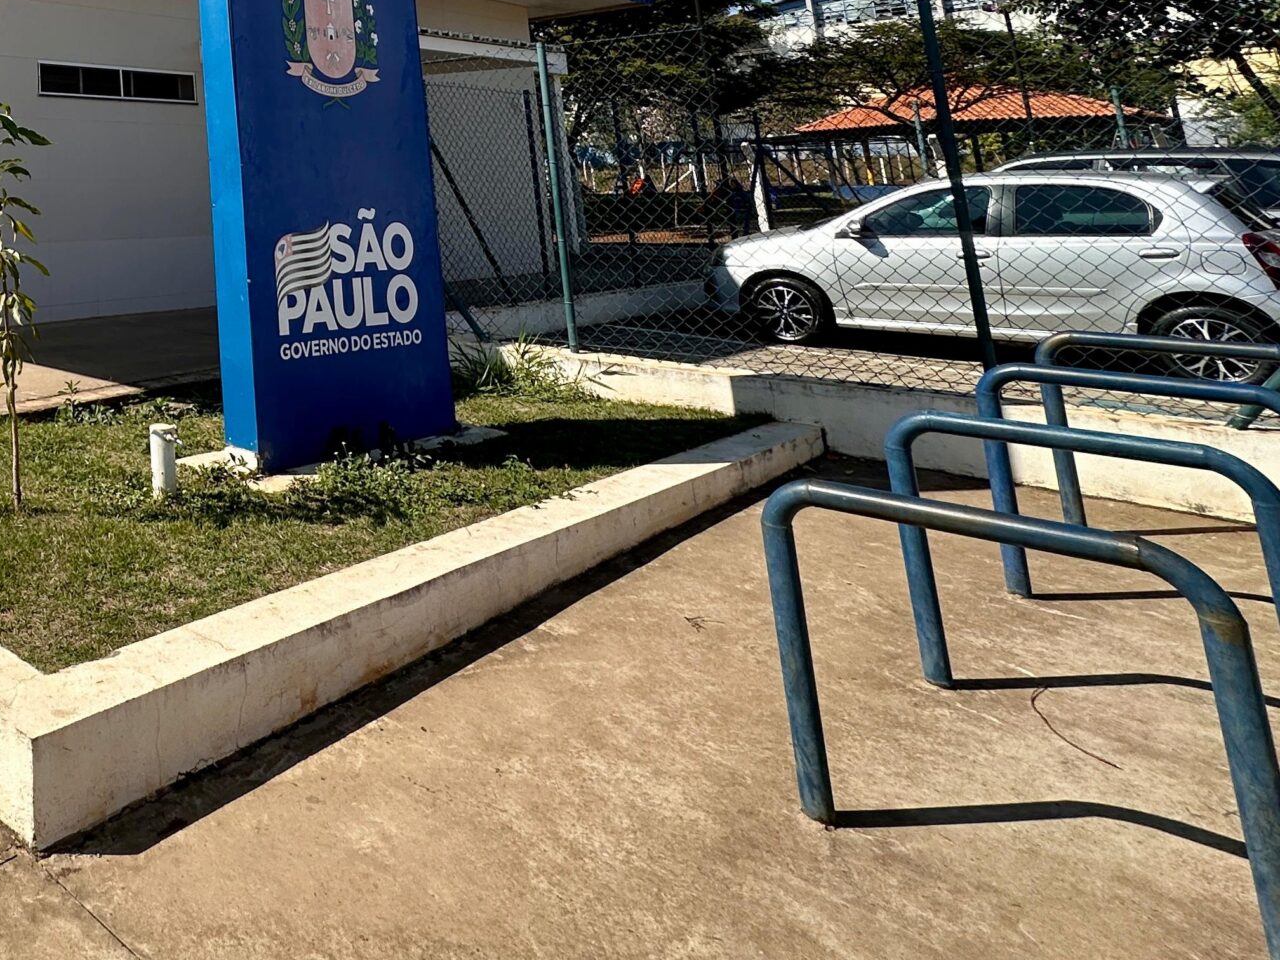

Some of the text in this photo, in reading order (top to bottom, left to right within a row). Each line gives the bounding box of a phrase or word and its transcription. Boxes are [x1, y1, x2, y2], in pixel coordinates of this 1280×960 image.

[328, 207, 414, 274] SÃO
[278, 273, 418, 337] PAULO
[280, 328, 422, 360] GOVERNO DO ESTADO
